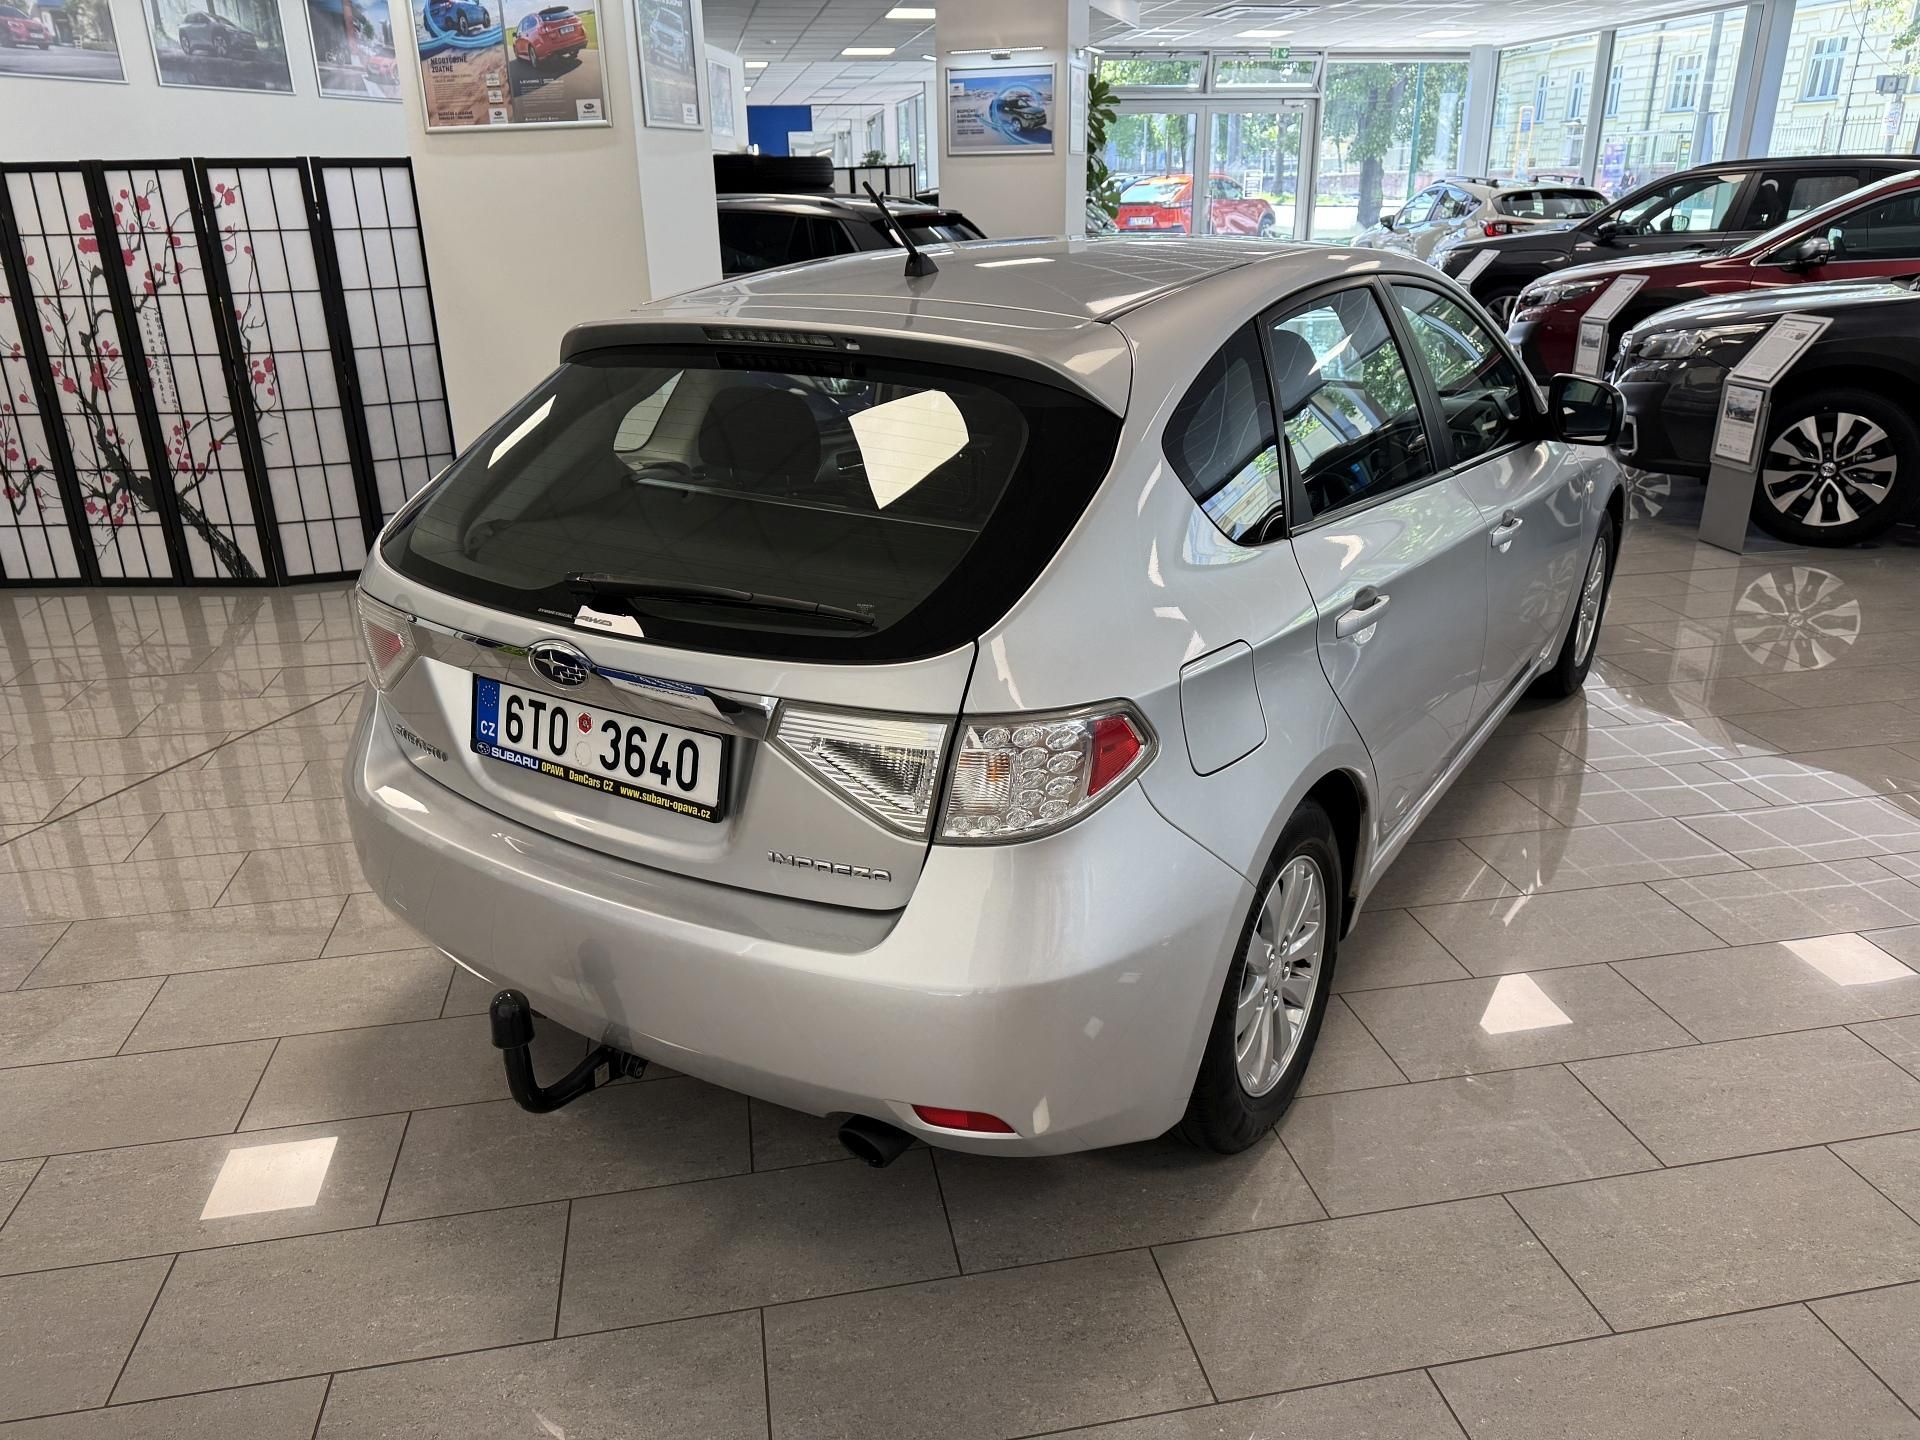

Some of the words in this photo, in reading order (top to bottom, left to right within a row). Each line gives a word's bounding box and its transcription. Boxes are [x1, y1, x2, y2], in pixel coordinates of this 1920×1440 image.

[480, 720, 496, 737] CZ
[600, 719, 699, 792] 3640
[491, 746, 539, 770] SUBARU
[541, 761, 565, 778] OPAVA
[569, 769, 601, 789] DanCars
[603, 779, 614, 792] CZ
[620, 785, 711, 819] www.subaru-opava.cz
